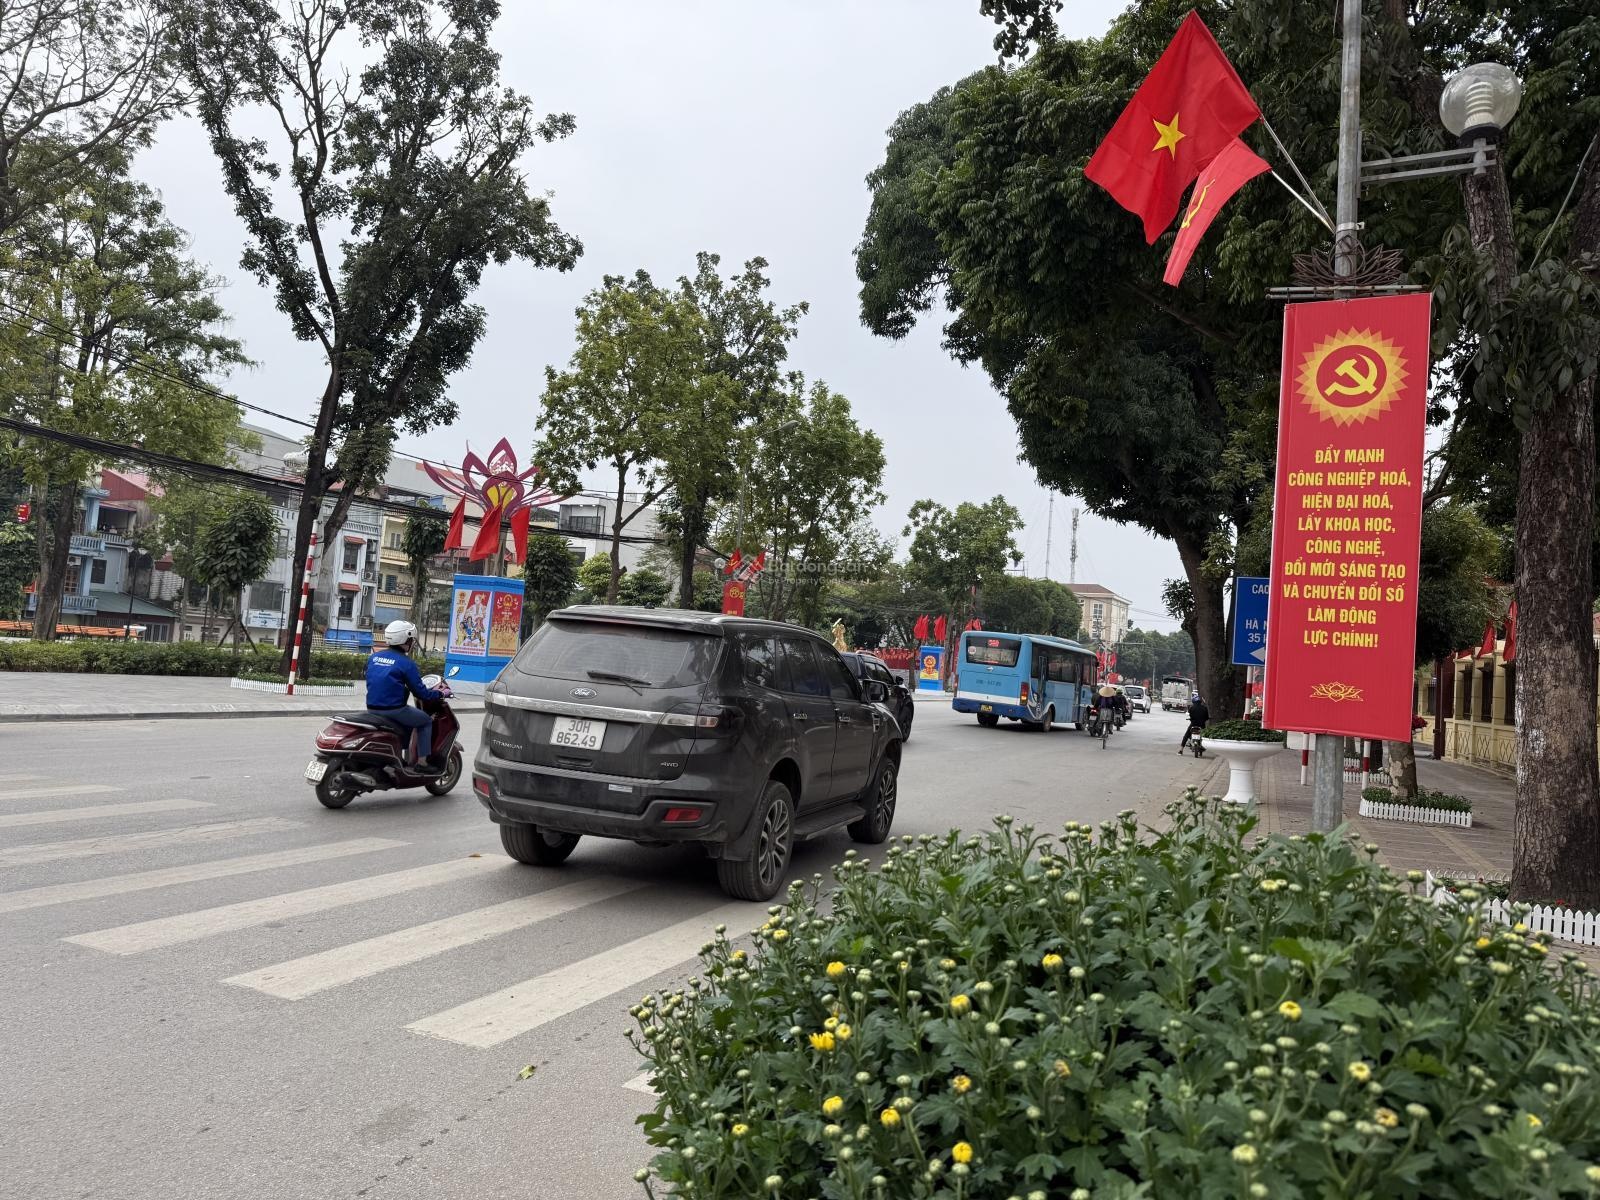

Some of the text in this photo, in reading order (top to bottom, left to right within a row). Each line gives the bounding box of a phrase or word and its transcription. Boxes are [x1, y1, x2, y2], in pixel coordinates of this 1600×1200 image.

[1315, 444, 1384, 466] ĐẨY MẠNH
[1288, 468, 1411, 488] CÔNG NGHIỆP HOÁ,
[1302, 492, 1394, 512] HIỆN ĐẠI HOÁ,
[1298, 512, 1396, 534] LẤY KHOA HỌC,
[1306, 536, 1384, 558] CÔNG NGHỆ,
[1284, 556, 1406, 581] ĐỔI MỚI SÁNG TẠO
[1283, 580, 1406, 602] VÀ CHUYỂN ĐỔI SỐ
[1245, 618, 1258, 630] HÀ
[1308, 605, 1376, 626] LÀM ĐỘNG
[1248, 632, 1261, 642] 35
[1304, 630, 1378, 648] LỰC CHÍNH!
[568, 720, 592, 734] 30H
[492, 739, 522, 750] TITANIUM
[556, 732, 597, 748] 862.49
